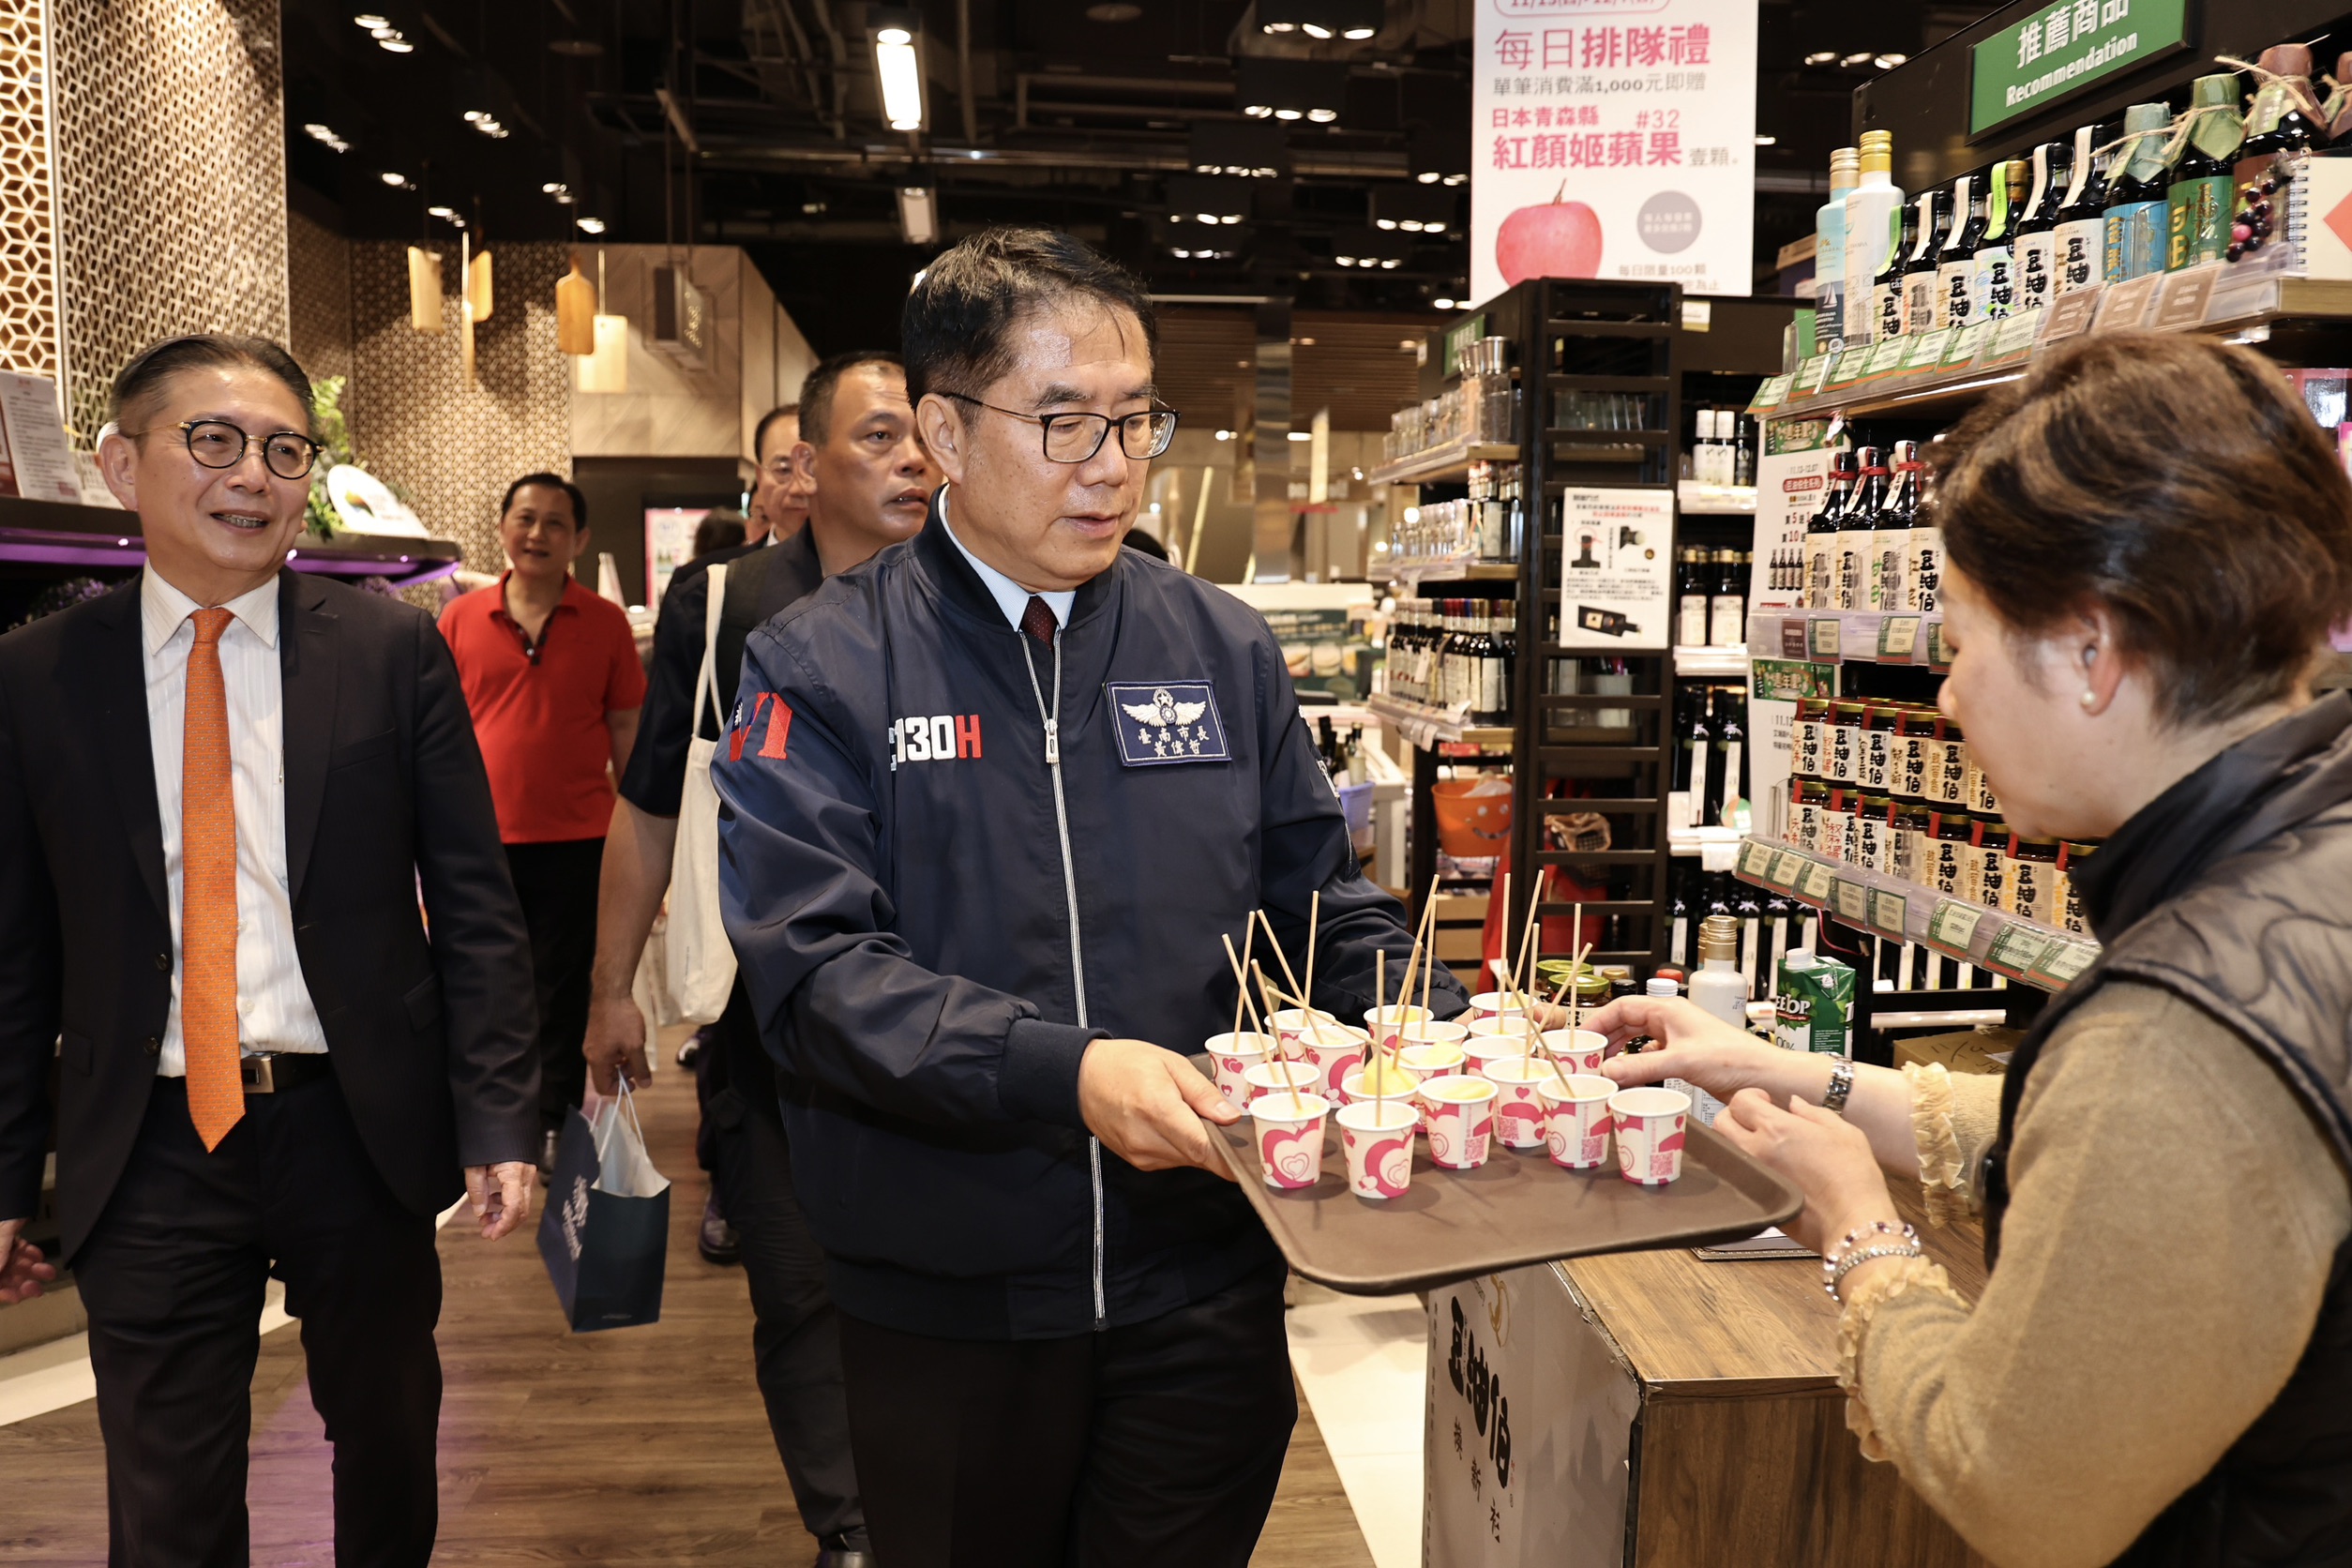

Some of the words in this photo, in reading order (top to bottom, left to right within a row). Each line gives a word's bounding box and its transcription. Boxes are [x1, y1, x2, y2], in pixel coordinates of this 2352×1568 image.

[1494, 23, 1710, 70] 每日排隊禮
[2016, 0, 2129, 69] 推薦商品
[1493, 72, 1706, 96] 單筆消費滿1,000元即贈
[2005, 32, 2138, 108] Recommendation
[1492, 105, 1599, 128] 日本青森縣
[1636, 110, 1680, 129] #32
[2065, 236, 2089, 291] 豆油
[1882, 295, 1902, 341] 豆油
[1919, 549, 1939, 611] 豆油伯
[1802, 724, 1817, 773] 豆油伯
[1833, 729, 1850, 778] 豆油伯
[1869, 734, 1887, 785] 豆油伯
[1906, 740, 1924, 793] 豆油伯
[1943, 745, 1963, 800] 豆油伯
[1983, 852, 2003, 908] 豆油伯
[2016, 864, 2037, 919] 豆油伯
[1448, 1295, 1512, 1489] 豆油伯
